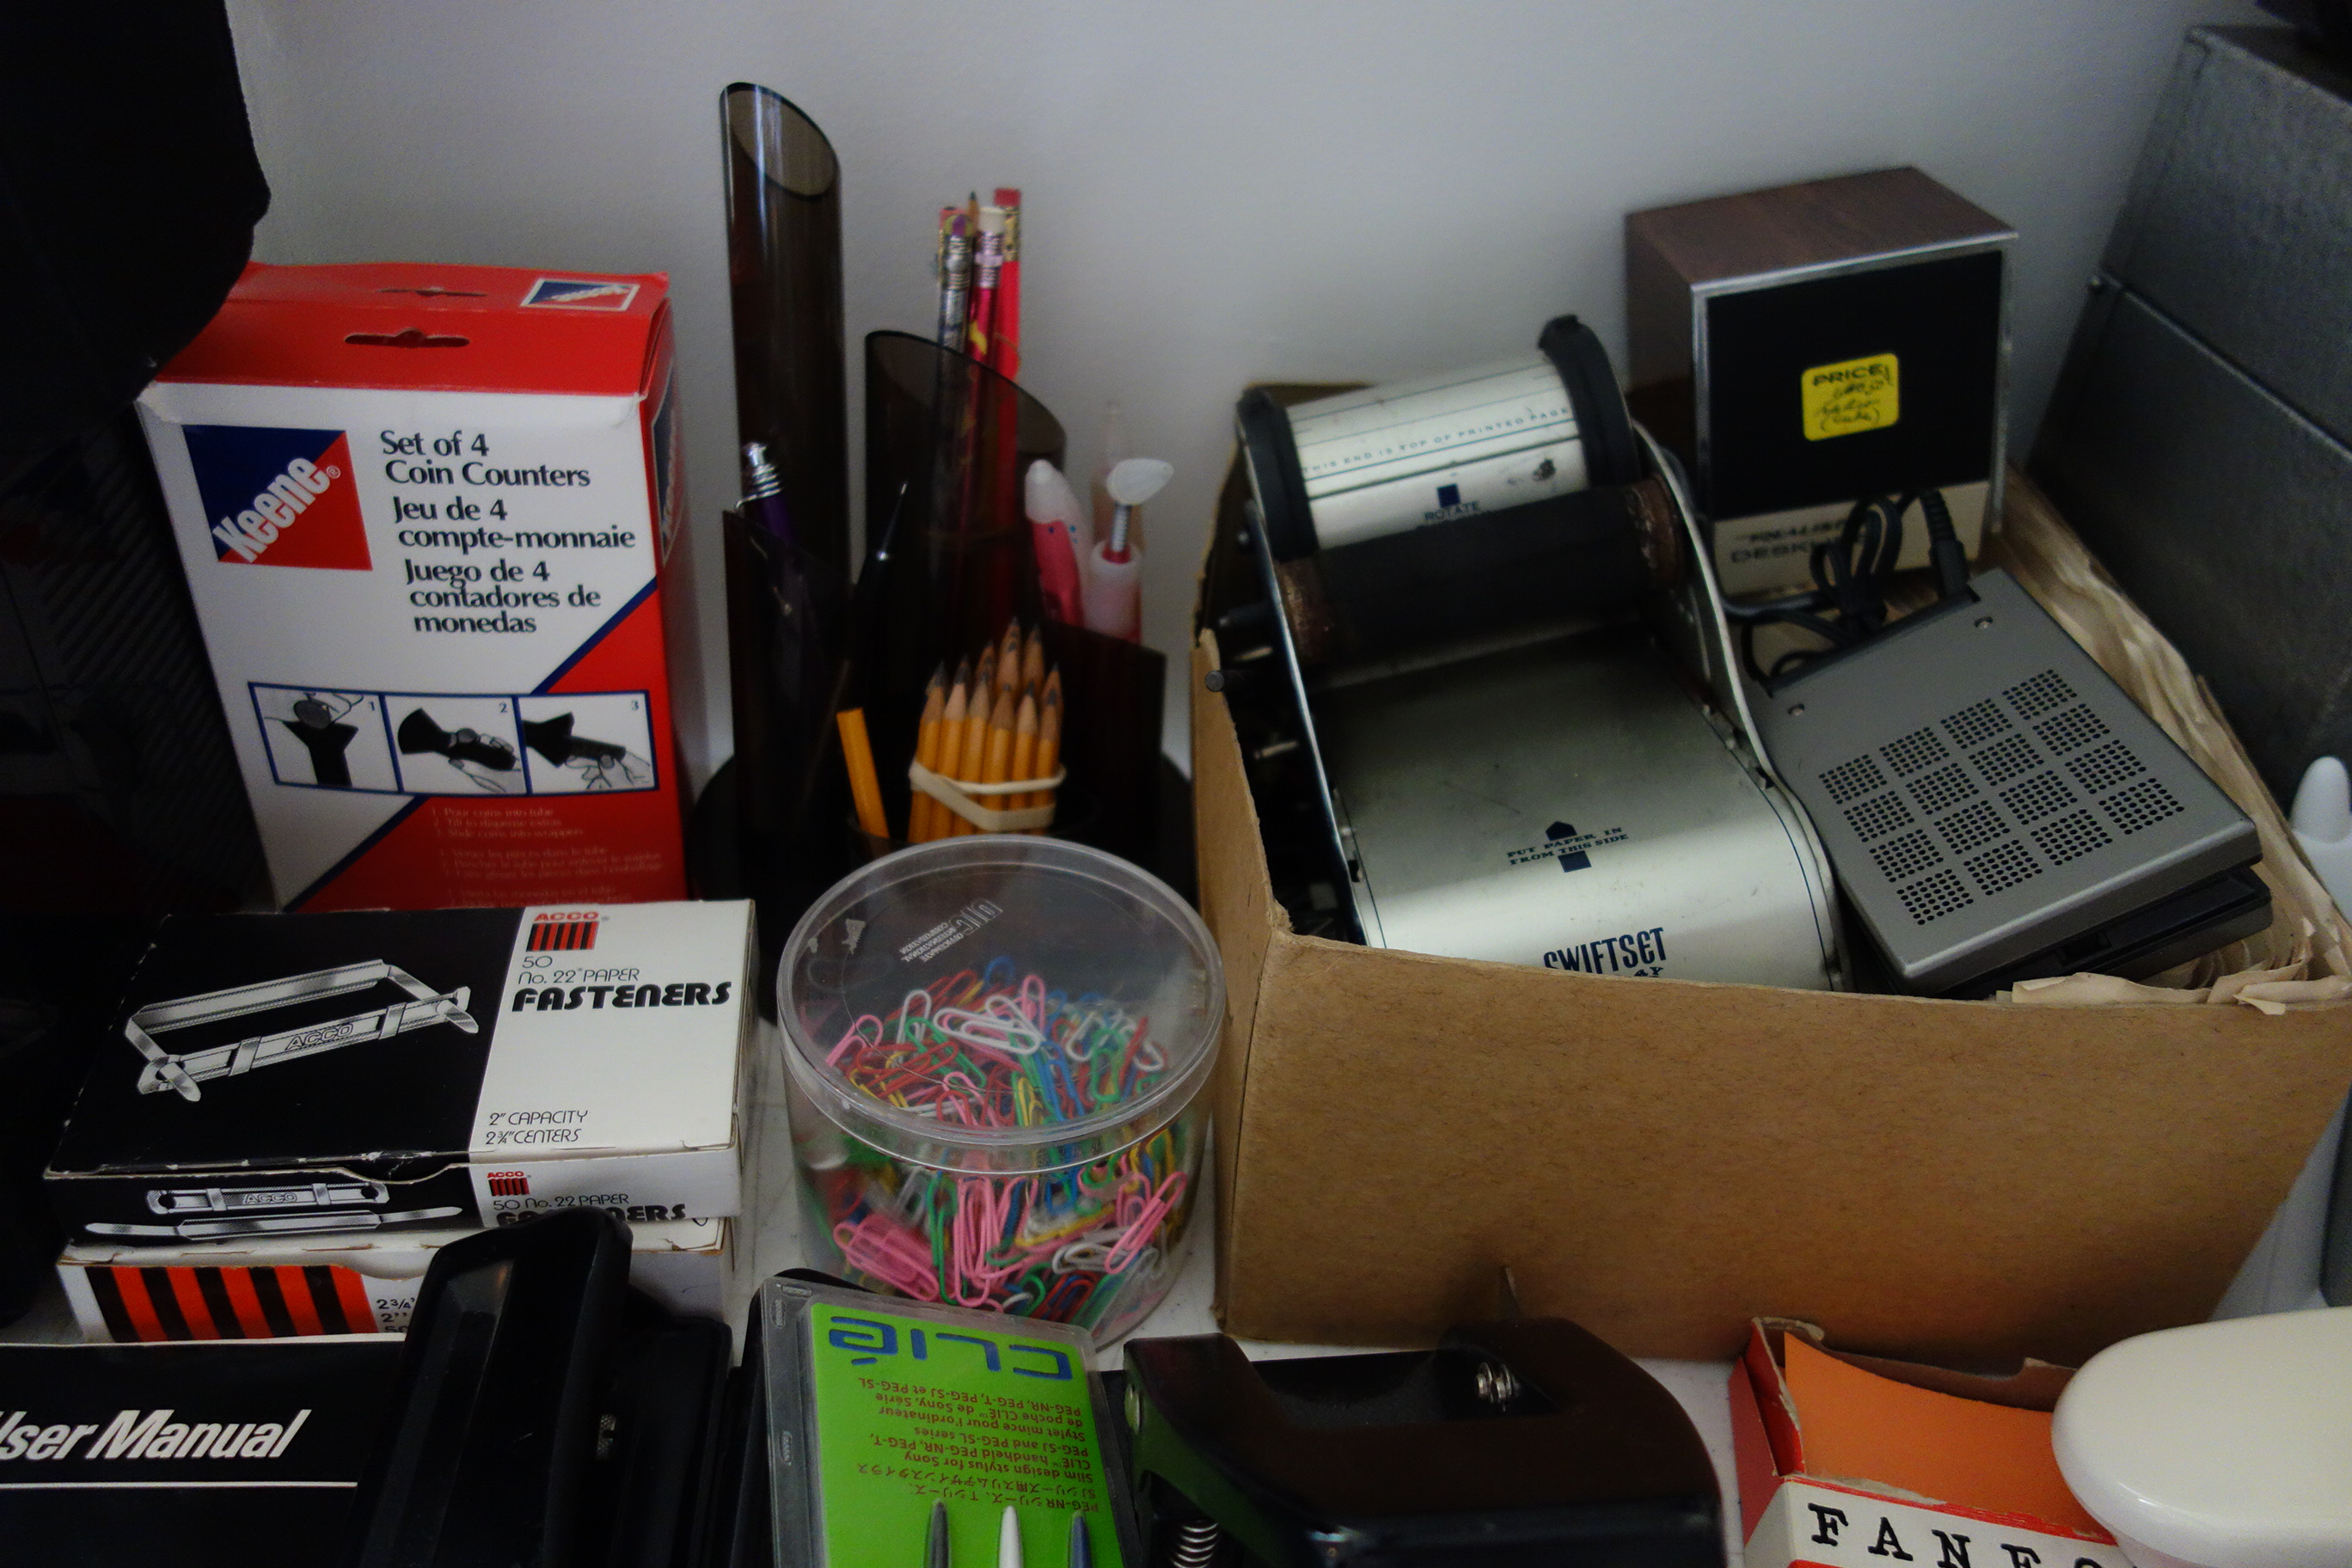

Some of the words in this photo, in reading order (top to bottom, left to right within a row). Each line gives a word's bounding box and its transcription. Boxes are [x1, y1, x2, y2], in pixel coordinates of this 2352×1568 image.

[1813, 364, 1883, 386] PRICE
[381, 430, 426, 456] Set
[433, 431, 462, 456] of
[471, 433, 489, 456] 4
[1302, 459, 1337, 473] THIS
[1344, 452, 1373, 464] END
[1379, 447, 1393, 457] IS
[1398, 439, 1428, 452] TOP
[1434, 433, 1452, 444] OF
[1459, 416, 1524, 438] PRINTED
[1530, 407, 1568, 421] PAGE
[385, 459, 454, 485] Coin
[462, 462, 591, 487] Counters
[393, 496, 438, 524] Jeu
[445, 496, 481, 521] de
[489, 499, 507, 521] 4
[398, 524, 636, 555] compte-monnaie
[404, 559, 482, 590] Juego
[490, 559, 524, 582] de
[532, 561, 550, 582] 4
[409, 585, 560, 607] contadores
[567, 585, 601, 607] de
[413, 610, 537, 633] monedas
[368, 701, 376, 712] 1
[499, 701, 509, 714] 2
[631, 700, 640, 711] 3
[1506, 846, 1536, 859] PUT
[1544, 833, 1596, 849] PAPER
[1604, 827, 1622, 836] IN
[1510, 850, 1555, 866] FROM
[1558, 842, 1592, 854] THIS
[1595, 834, 1629, 846] SIDE
[533, 911, 599, 922] ACCO
[1543, 927, 1666, 974] SWIFTSET
[521, 955, 553, 969] 50
[583, 968, 640, 983] PAPER
[511, 981, 732, 1012] FASTENERS
[285, 1022, 354, 1051] ACCO
[508, 1110, 588, 1126] CAPACITY
[514, 1128, 582, 1144] CENTERS
[487, 1170, 525, 1179] ACCO
[244, 1191, 298, 1204] ACCO
[493, 1200, 520, 1211] 50
[554, 1196, 577, 1208] 22
[579, 1193, 630, 1207] PAPER
[858, 1377, 909, 1394] PEG-SL
[912, 1385, 927, 1395] et
[875, 1393, 912, 1408] Série
[929, 1387, 977, 1403] PEG-SJ
[980, 1393, 1024, 1409] PEG-T,
[957, 1404, 974, 1415] de
[1027, 1400, 1081, 1417] PEG-NR,
[967, 1417, 999, 1430] pour
[1022, 1411, 1063, 1425] poche
[1067, 1418, 1083, 1429] de
[85, 1409, 312, 1459] Manual
[914, 1426, 956, 1441] series
[1003, 1422, 1044, 1436] mince
[1046, 1427, 1086, 1442] Stylet
[869, 1433, 916, 1450] PEG-T,
[959, 1432, 1008, 1448] PEG-SL
[1011, 1438, 1038, 1451] and
[920, 1440, 977, 1458] PEG-NR,
[1042, 1442, 1089, 1457] PEG-SJ
[904, 1451, 940, 1467] Sony
[944, 1458, 964, 1470] for
[982, 1449, 1048, 1466] handheld
[968, 1460, 1010, 1474] stylus
[1014, 1463, 1060, 1479] design
[1064, 1471, 1093, 1483] Slim
